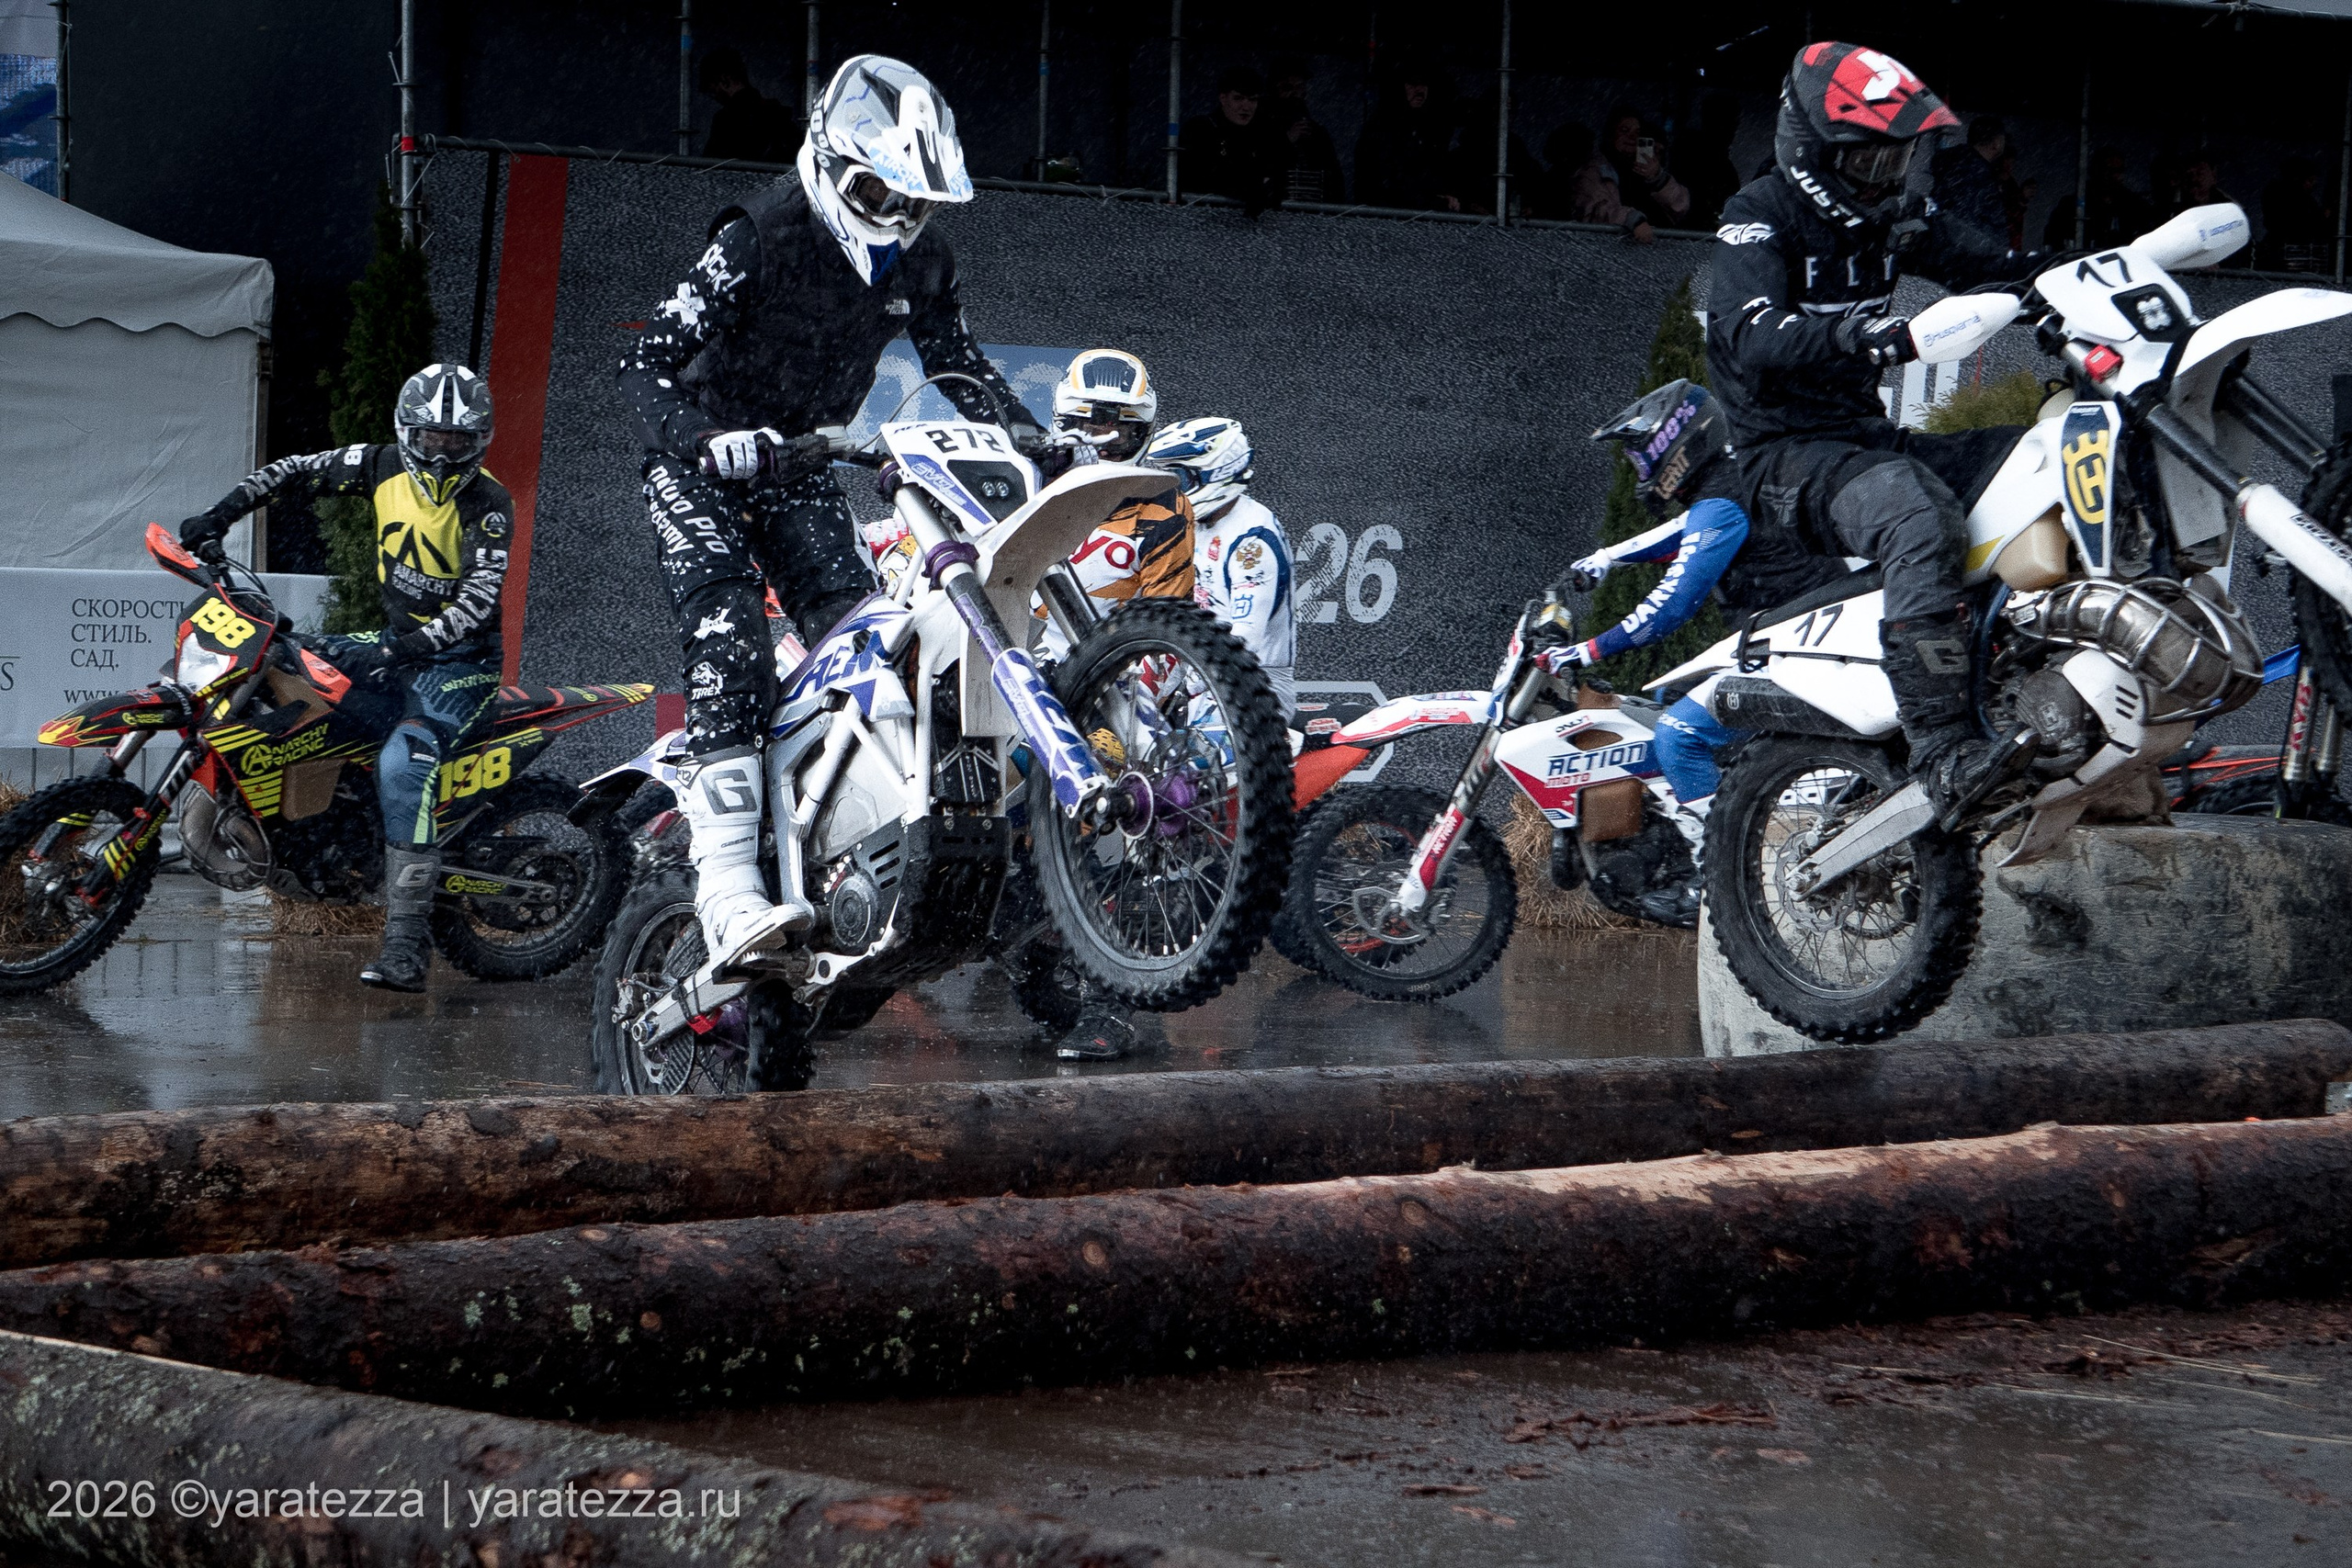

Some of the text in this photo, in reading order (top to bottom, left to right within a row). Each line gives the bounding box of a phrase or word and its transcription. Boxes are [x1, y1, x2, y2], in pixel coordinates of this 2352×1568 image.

[873, 152, 922, 189] AIROH
[2075, 253, 2133, 288] 17
[1646, 400, 1697, 460] 100%
[684, 516, 730, 554] Pro
[71, 624, 152, 643] СТИЛЬ.
[189, 597, 256, 649] 198
[1793, 603, 1845, 648] 17
[70, 649, 119, 671] САД.
[273, 737, 325, 766] RACING
[1548, 743, 1646, 777] ACTION
[438, 746, 512, 803] 198
